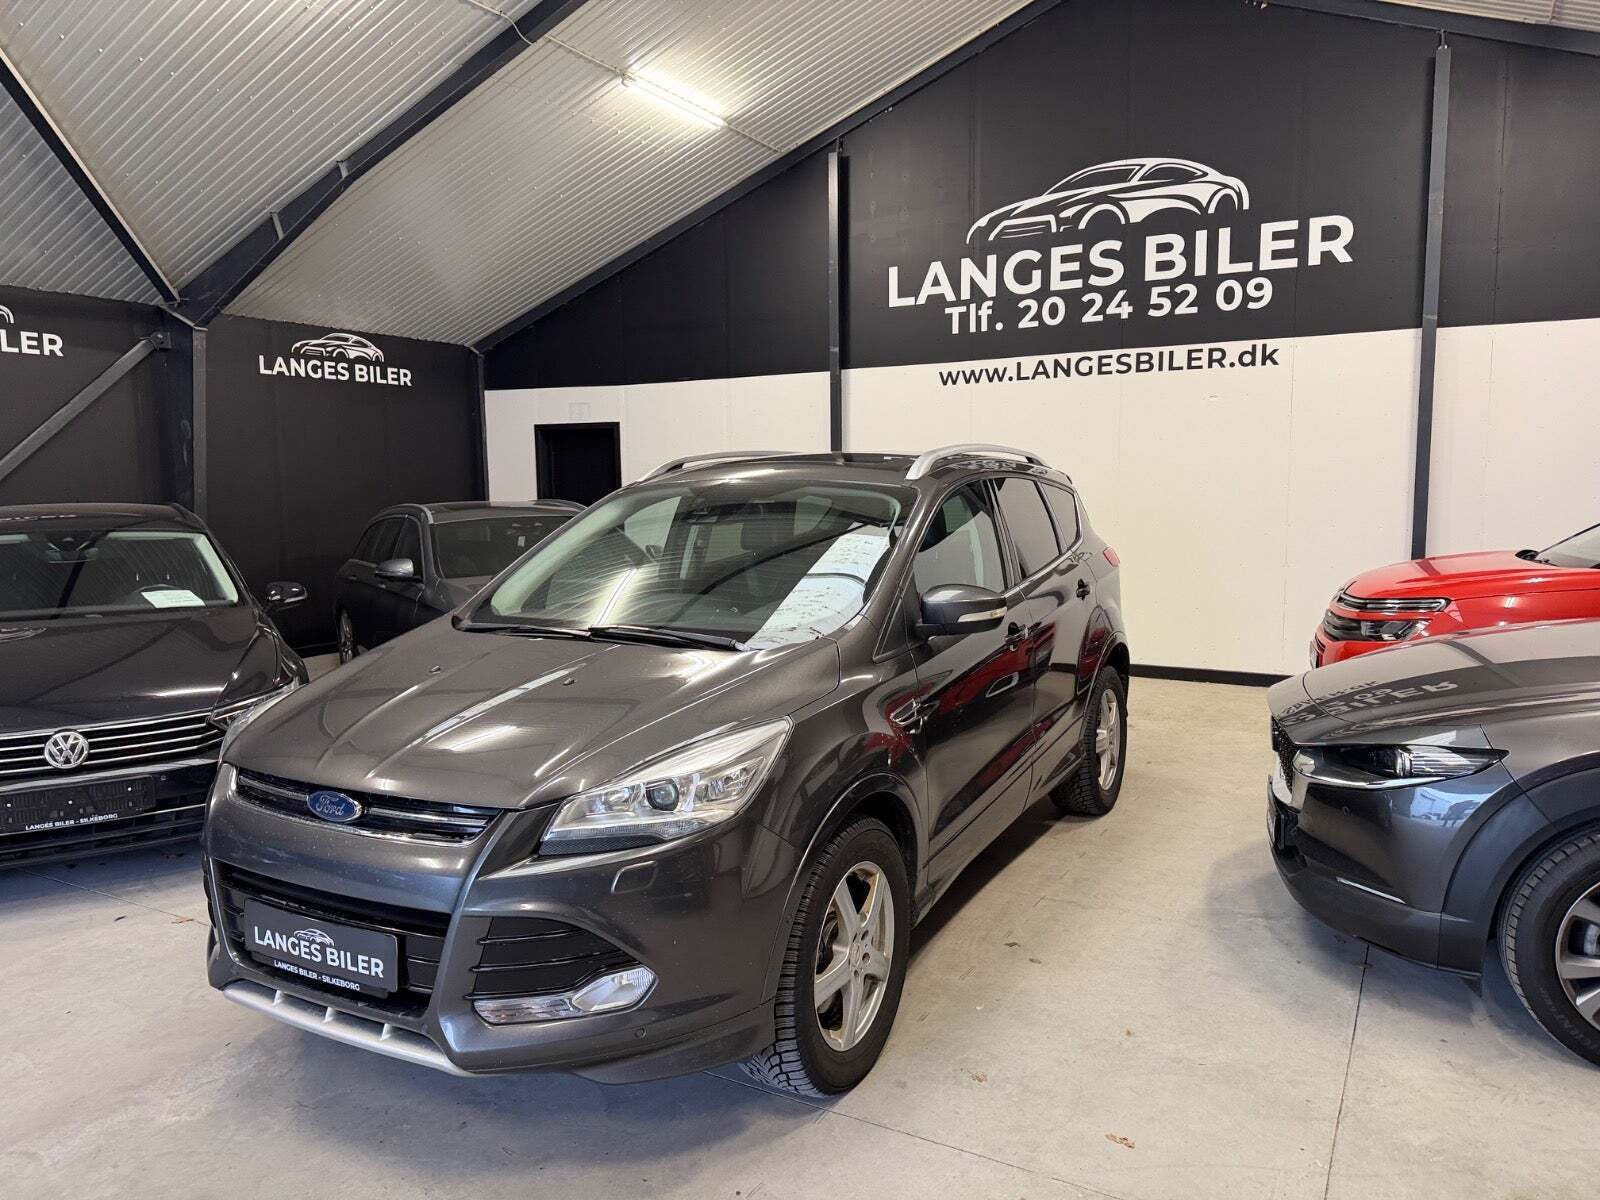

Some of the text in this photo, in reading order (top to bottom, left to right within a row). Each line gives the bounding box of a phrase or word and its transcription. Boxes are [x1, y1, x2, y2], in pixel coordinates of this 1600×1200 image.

[887, 214, 1355, 309] LANGES BILER
[944, 276, 1274, 335] Tlf. 20 24 52 09
[258, 354, 413, 387] LANGES BILER
[938, 343, 1280, 387] www.LANGESBILER.dk
[54, 819, 75, 828] BILER
[314, 794, 346, 816] Ford
[254, 925, 384, 979] LANGES BILER
[273, 960, 299, 974] LANGES
[298, 967, 318, 980] BILER
[321, 975, 361, 991] SILKEBORG
